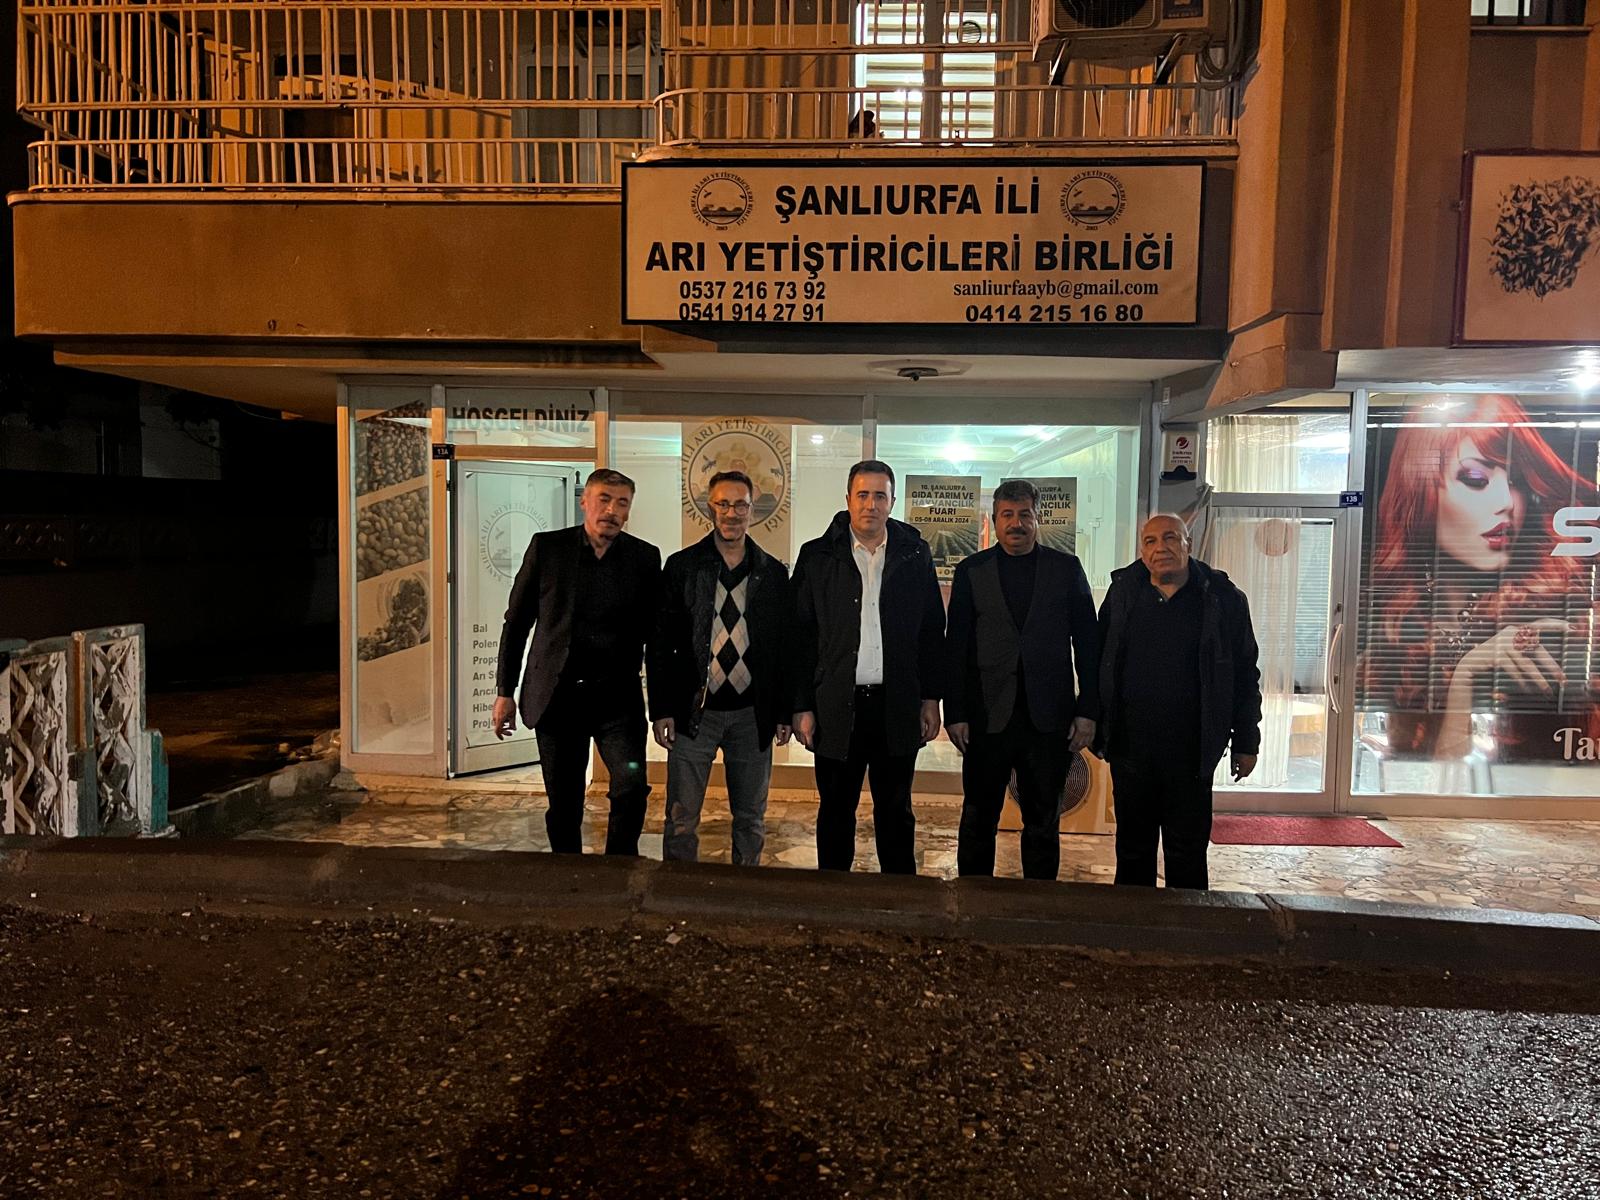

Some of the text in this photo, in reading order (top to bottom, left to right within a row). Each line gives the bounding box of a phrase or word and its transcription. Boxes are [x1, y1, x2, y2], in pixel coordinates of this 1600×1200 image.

[774, 176, 1040, 224] ŞANLIURFA İLİ
[645, 232, 1173, 280] ARI YETİŞTİRİCİLERİ BİRLİĞİ
[679, 280, 826, 300] 0537 216 73 92
[953, 279, 1159, 300] sanliurfaayb@gmail.com
[678, 303, 824, 321] 0541 914 27 91
[965, 304, 1144, 322] 0414 215 16 80
[451, 403, 590, 436] HOŞGELDİNİZ
[911, 491, 975, 500] GIDA TARIM VE
[1058, 493, 1071, 501] VE
[911, 499, 976, 508] HAYVANCILIK
[929, 507, 956, 515] FUARI
[472, 624, 488, 633] Bal
[472, 640, 498, 650] Polen
[472, 672, 486, 681] Arı
